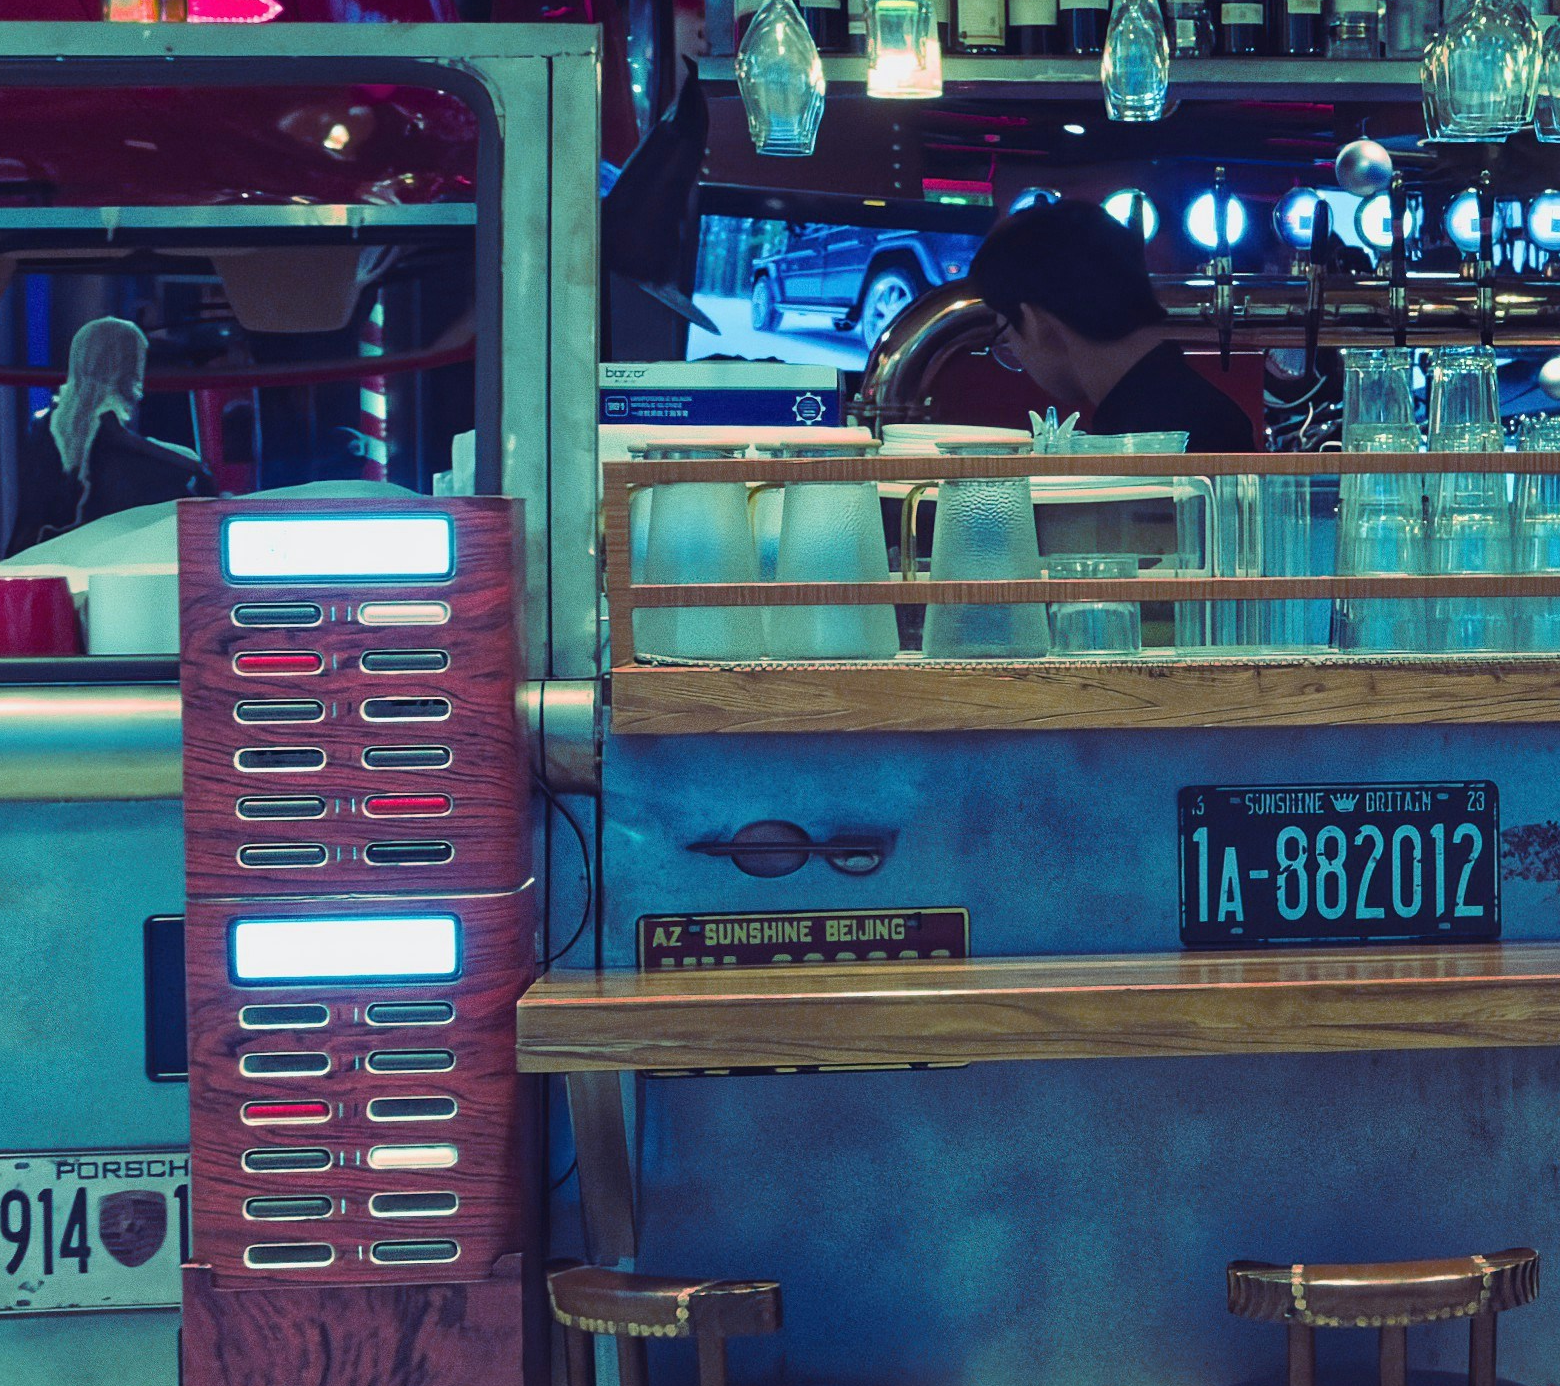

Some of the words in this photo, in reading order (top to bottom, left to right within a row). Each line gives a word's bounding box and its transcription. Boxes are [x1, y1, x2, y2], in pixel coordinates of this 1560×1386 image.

[1244, 791, 1325, 815] SUNSHINE
[1365, 791, 1432, 814] BRITAIN
[1192, 822, 1484, 922] 1A-882012
[651, 926, 683, 948] AZ
[704, 919, 813, 946] SUNSHINE
[825, 917, 905, 942] BEIJING
[55, 1159, 189, 1181] PORSCH
